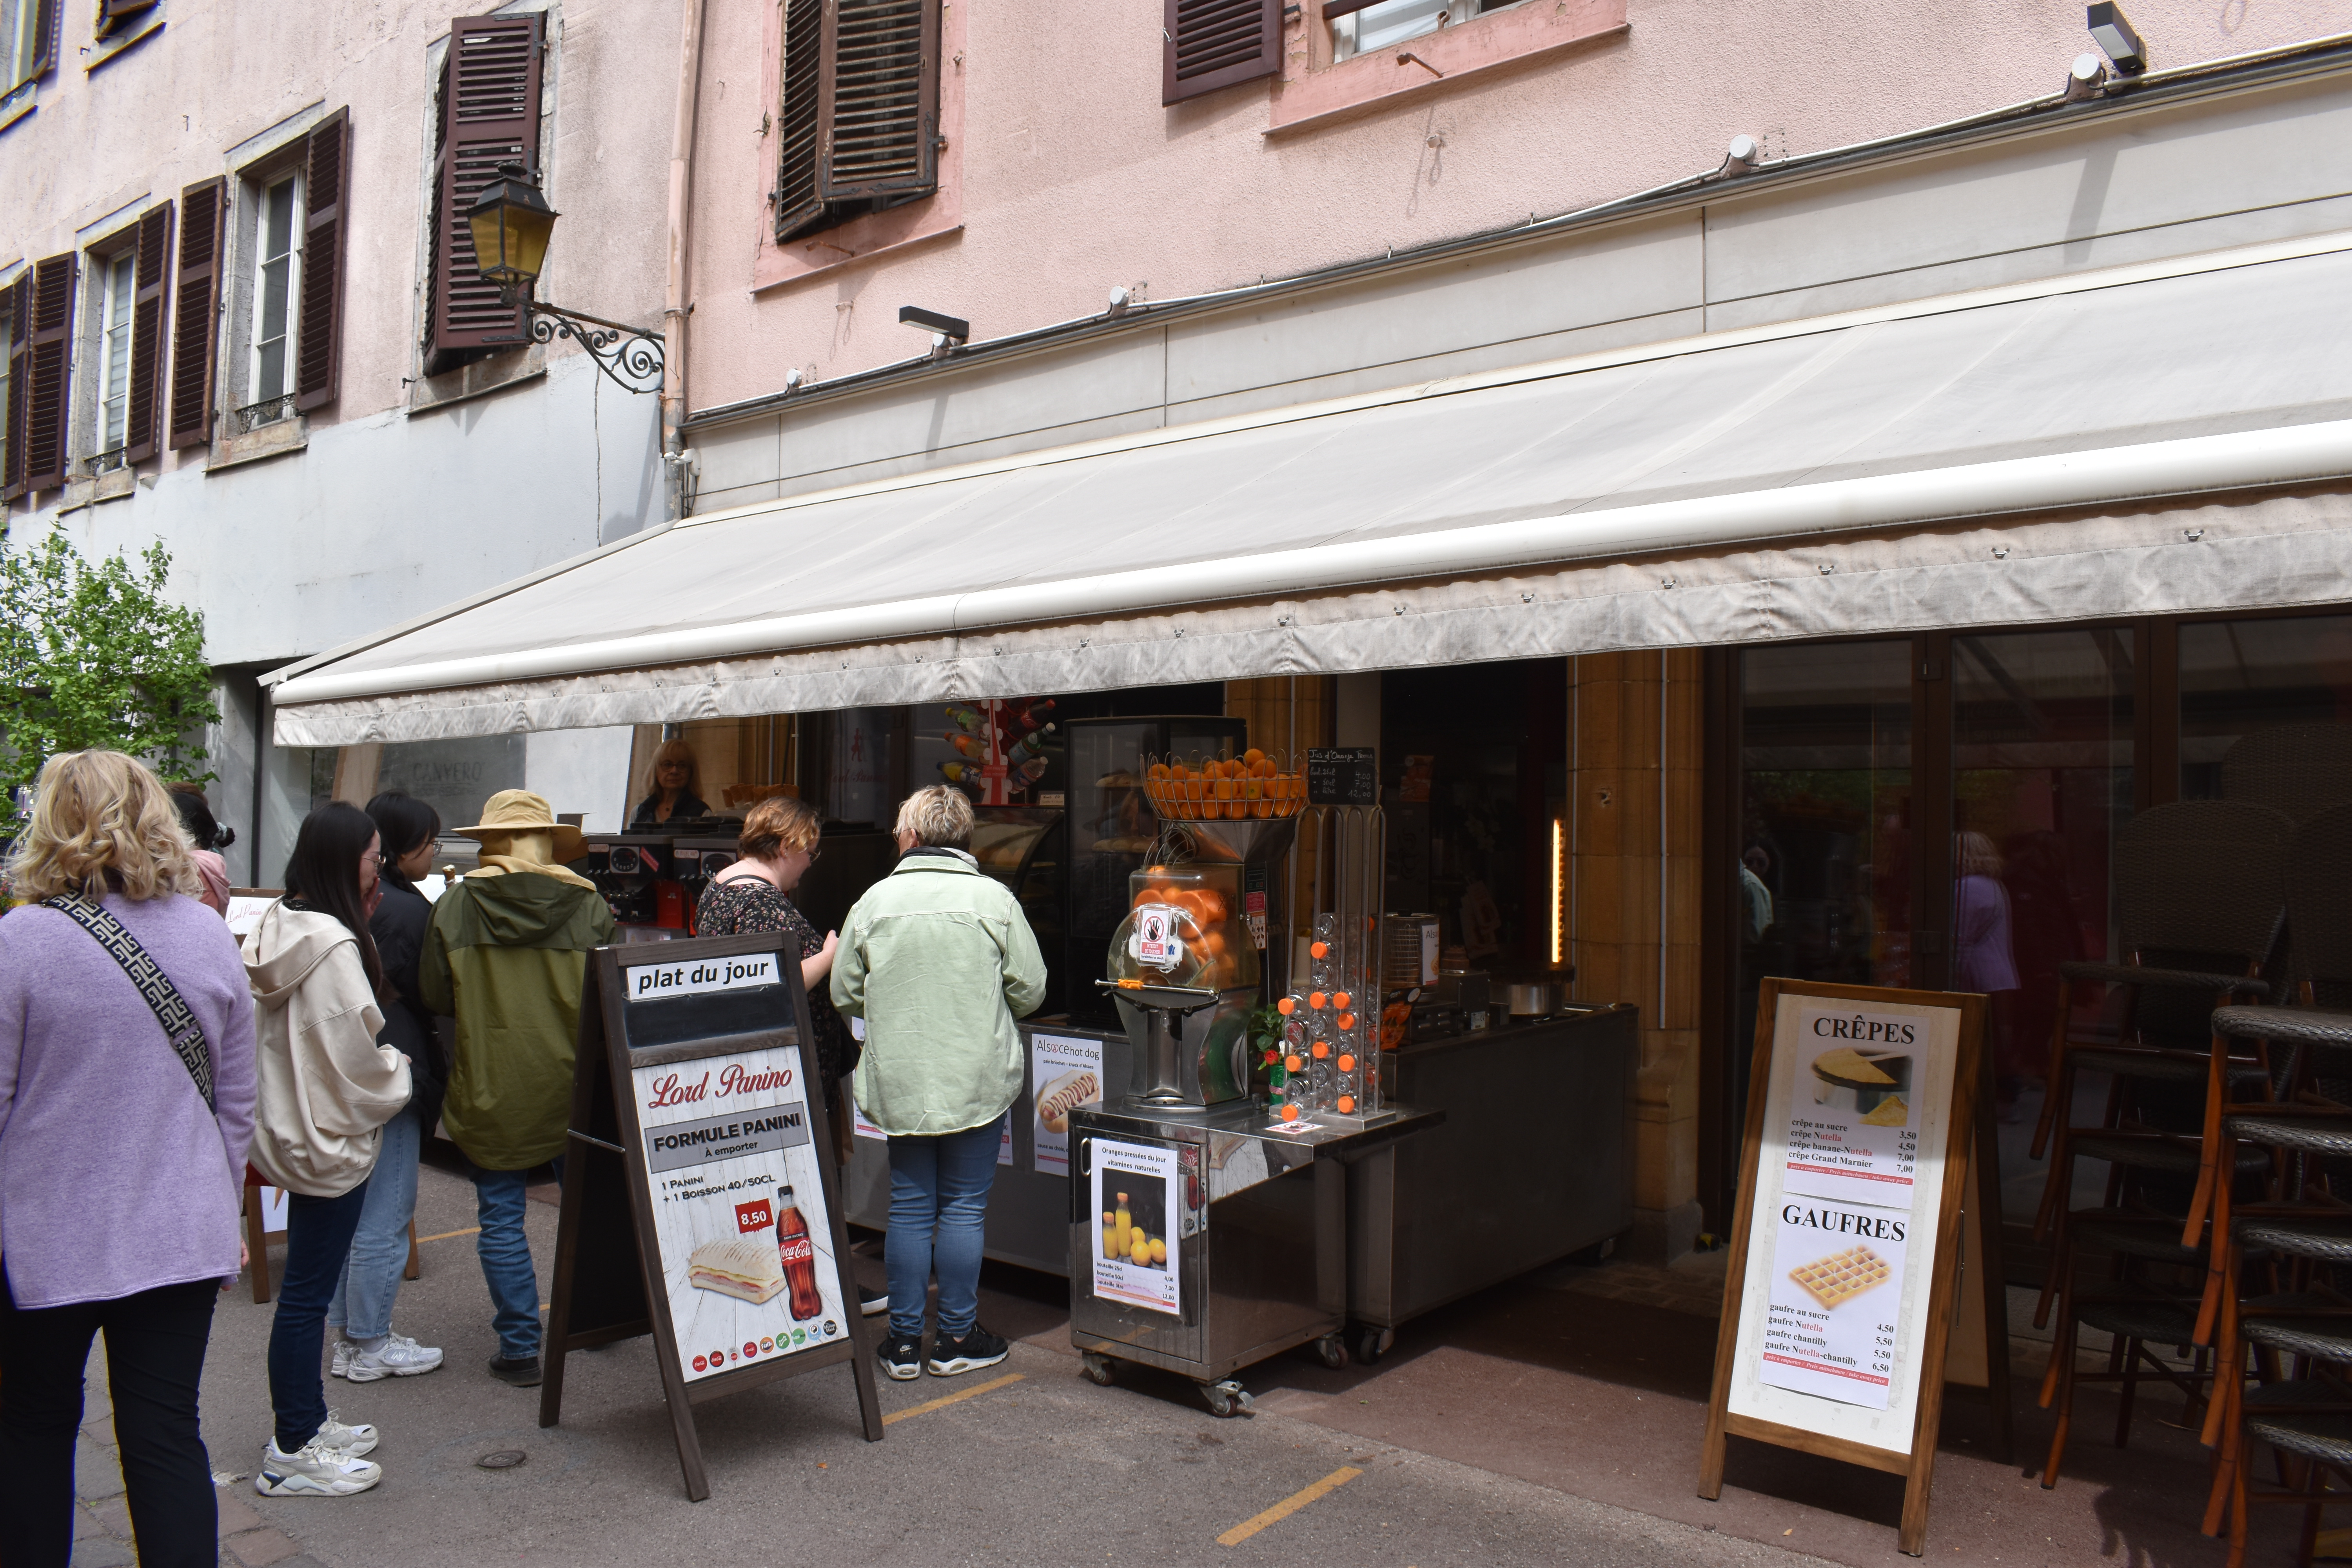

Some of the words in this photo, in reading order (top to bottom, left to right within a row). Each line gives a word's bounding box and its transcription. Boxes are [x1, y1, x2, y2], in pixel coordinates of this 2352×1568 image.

[243, 904, 262, 918] Panin
[638, 968, 684, 994] plat
[691, 964, 717, 984] du
[723, 962, 769, 985] jour
[1813, 1014, 1915, 1044] CRÊPES
[1070, 1046, 1083, 1057] hot
[1085, 1048, 1099, 1060] dog
[648, 1071, 709, 1109] Lord
[715, 1064, 792, 1098] Panino
[653, 1123, 740, 1151] FORMULE
[743, 1112, 802, 1136] PANINI
[1791, 1119, 1813, 1129] crêpe
[1899, 1131, 1916, 1140] 3,50
[705, 1147, 712, 1158] À
[715, 1142, 758, 1156] emporter
[1789, 1140, 1811, 1150] crêpe
[1813, 1142, 1872, 1157] banane-Nutella
[1897, 1153, 1914, 1162] 7,00
[1791, 1130, 1812, 1139] crêpe
[1814, 1131, 1842, 1142] Nutella
[1898, 1142, 1915, 1151] 4,50
[1102, 1147, 1123, 1156] Oranges
[1124, 1151, 1146, 1160] pressées
[1788, 1151, 1809, 1161] crêpe
[1811, 1153, 1837, 1163] Grand
[1840, 1156, 1873, 1168] Marnier
[1896, 1164, 1913, 1173] 7,00
[1107, 1160, 1132, 1169] vitamines
[1135, 1165, 1160, 1173] naturelles
[728, 1174, 776, 1190] 40/50CL
[741, 1210, 767, 1226] 8.50
[1782, 1205, 1905, 1242] GAUFRES
[1096, 1261, 1114, 1270] bouteille
[1097, 1270, 1114, 1278] bouteille
[1097, 1279, 1114, 1287] bouteille
[1769, 1304, 1795, 1314] gaufre
[1808, 1312, 1829, 1321] sucre
[1877, 1323, 1894, 1333] 4,50
[1768, 1317, 1793, 1327] gaufre
[1795, 1319, 1823, 1332] Nutella
[1875, 1336, 1892, 1346] 5,50
[1766, 1329, 1791, 1339] gaufre
[1793, 1334, 1827, 1348] chantilly
[1874, 1349, 1891, 1359] 5,50
[1765, 1341, 1790, 1352] gaufre
[1792, 1345, 1857, 1367] Nutella-chantilly
[1872, 1362, 1889, 1372] 6,50
